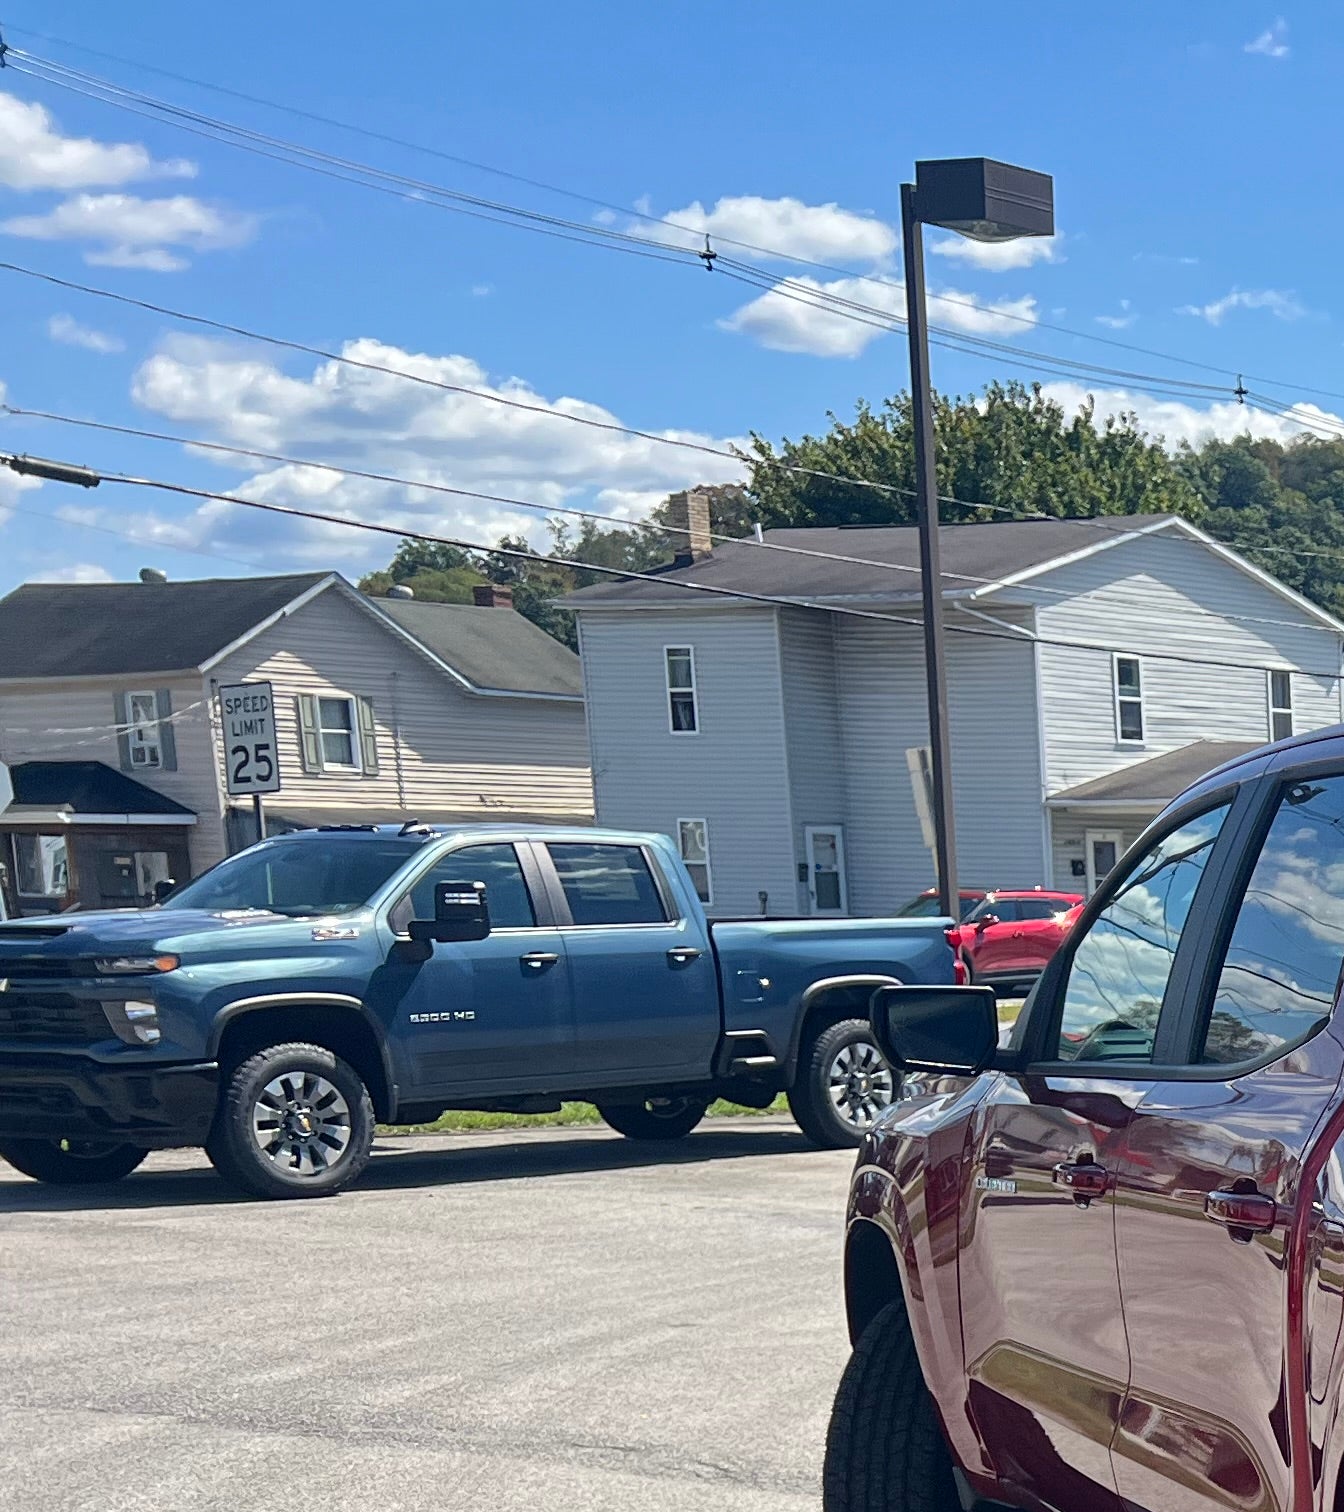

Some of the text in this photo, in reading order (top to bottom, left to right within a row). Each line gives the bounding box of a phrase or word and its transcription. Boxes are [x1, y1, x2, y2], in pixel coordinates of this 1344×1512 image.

[225, 695, 268, 714] SPEED
[231, 719, 265, 737] LIMIT
[231, 743, 273, 784] 25
